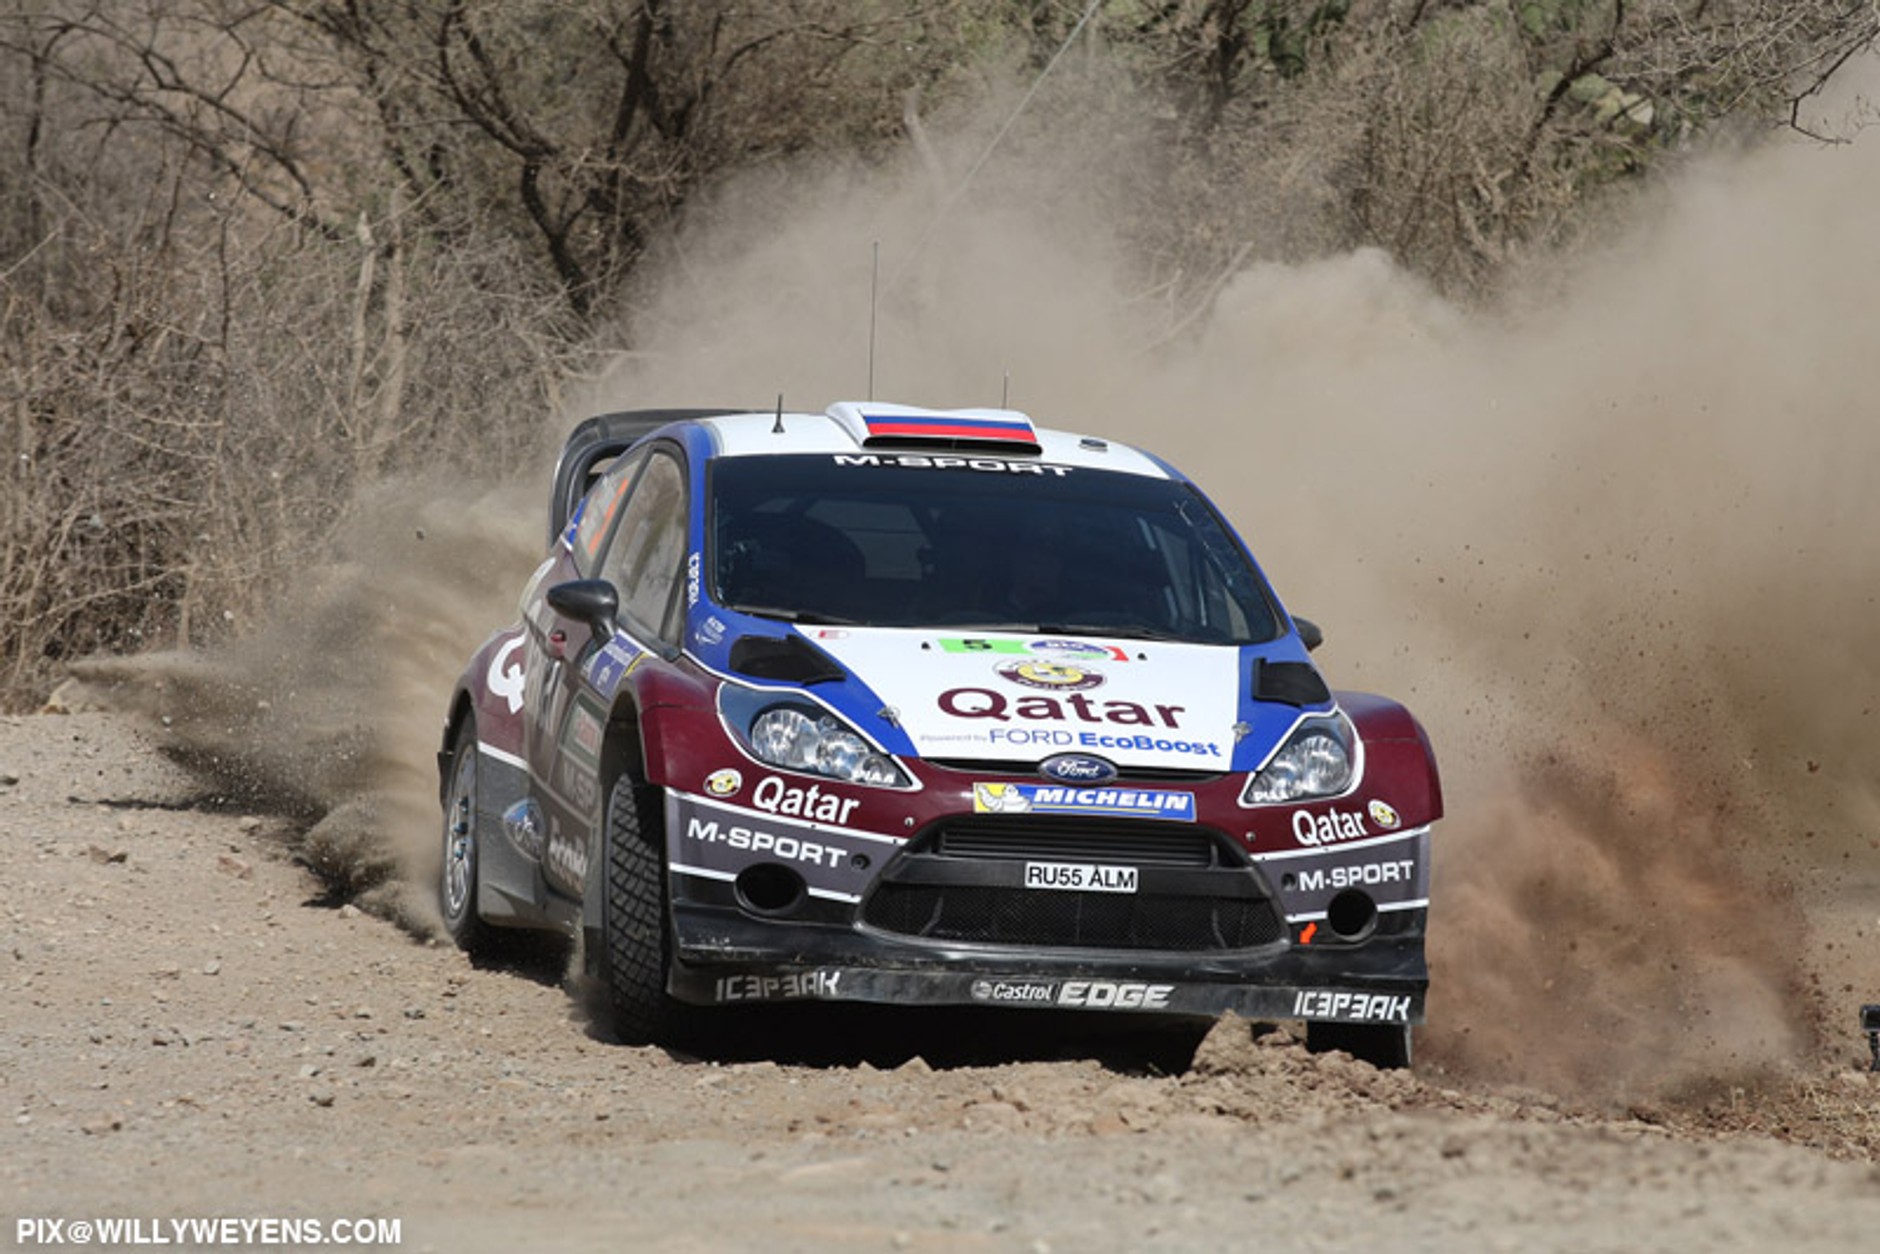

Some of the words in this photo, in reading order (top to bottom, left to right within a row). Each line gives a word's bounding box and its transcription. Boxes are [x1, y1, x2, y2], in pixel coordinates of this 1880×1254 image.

[834, 455, 1073, 477] M-SPORT
[937, 687, 1186, 729] Qatar
[989, 728, 1074, 746] FORD
[1079, 732, 1223, 757] EcoBoost
[1056, 760, 1101, 778] Ford
[753, 776, 860, 825] Qatar
[1033, 788, 1189, 811] MICHELIN
[1292, 806, 1369, 848] Qatar
[687, 818, 848, 868] M-SPORT
[1027, 866, 1083, 887] RU55
[1087, 868, 1136, 890] ALM
[1299, 859, 1414, 891] M-SPORT
[993, 981, 1053, 1001] Castrol
[1057, 981, 1176, 1009] EDGE
